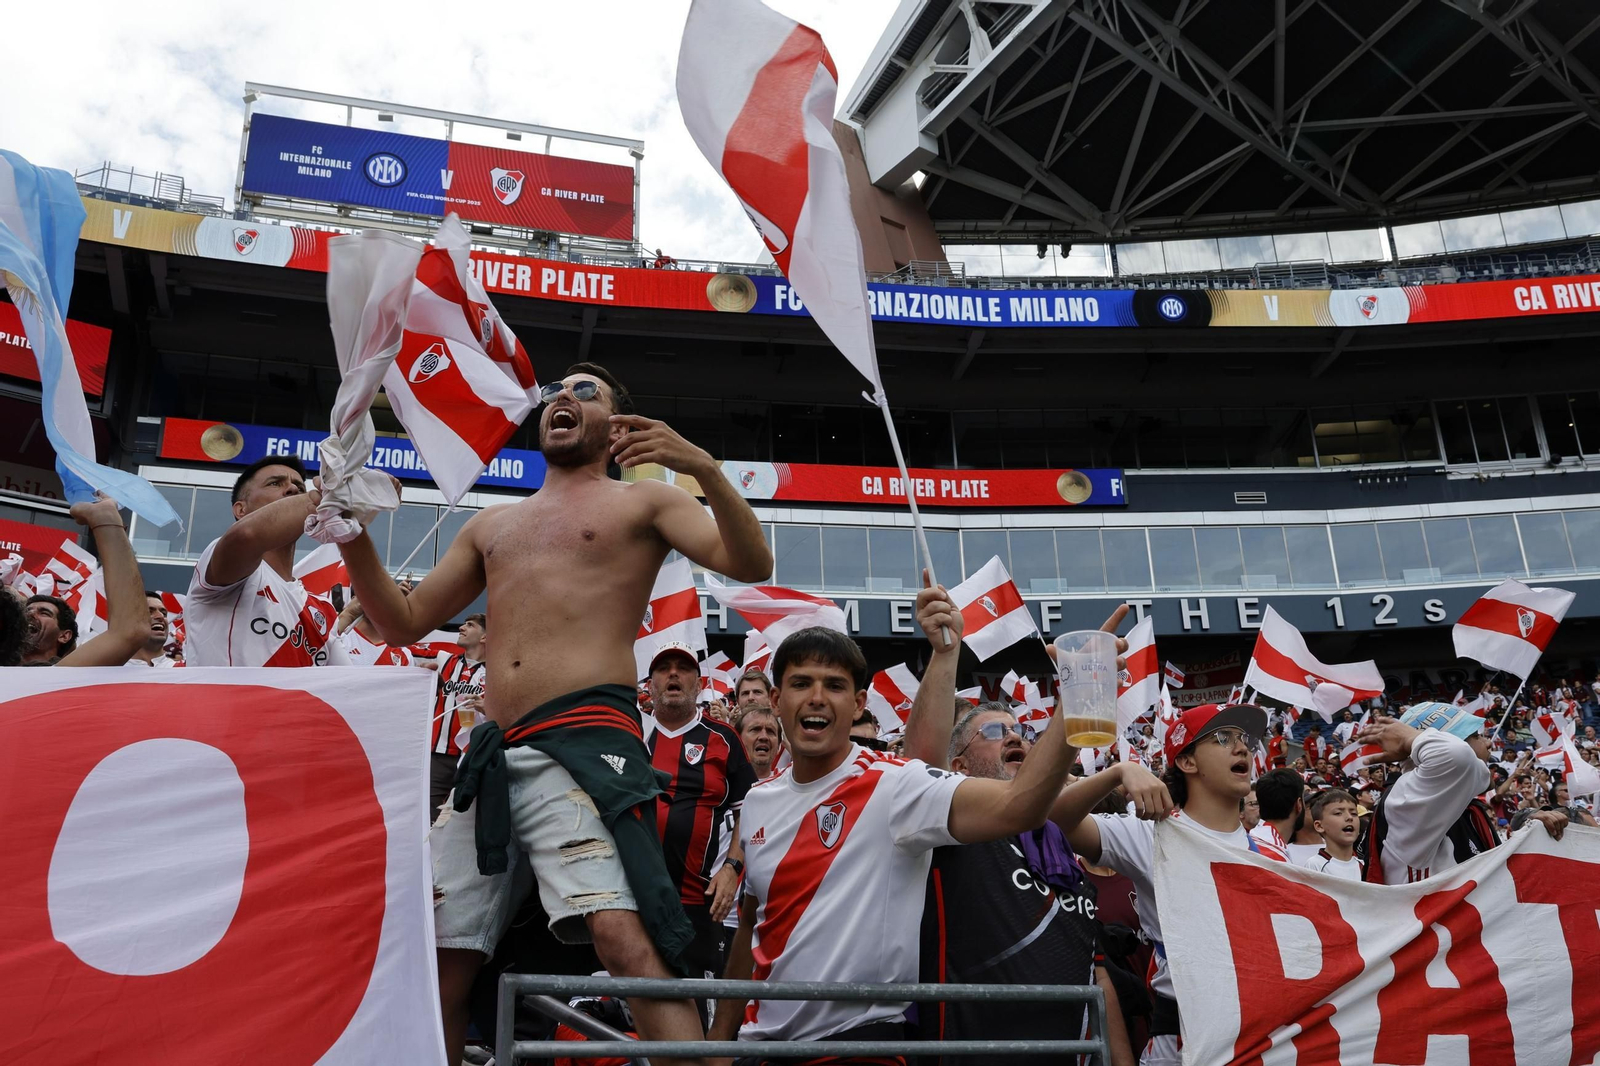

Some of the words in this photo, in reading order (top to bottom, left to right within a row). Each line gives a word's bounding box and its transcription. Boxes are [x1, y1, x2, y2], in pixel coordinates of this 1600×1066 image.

[279, 152, 352, 170] INTERNAZIONALE
[311, 145, 323, 155] FC
[297, 166, 332, 178] MILANO
[440, 169, 454, 190] V
[434, 195, 454, 203] WORLD
[455, 197, 467, 205] CUP
[541, 187, 552, 197] CA
[555, 189, 578, 201] RIVER
[580, 192, 605, 204] PLATE
[113, 209, 133, 240] V
[541, 267, 615, 300] PLATE
[774, 284, 802, 311] FC
[868, 290, 1002, 323] RNAZIONALE
[1009, 297, 1100, 323] MILANO
[1262, 295, 1279, 321] V
[1513, 286, 1548, 311] CA
[266, 437, 290, 457] FC
[861, 476, 884, 496] CA
[941, 480, 990, 499] PLATE
[0, 540, 21, 552] LATE
[1126, 597, 1261, 630] THE
[1326, 593, 1447, 628] 12s
[1012, 868, 1096, 920] coere
